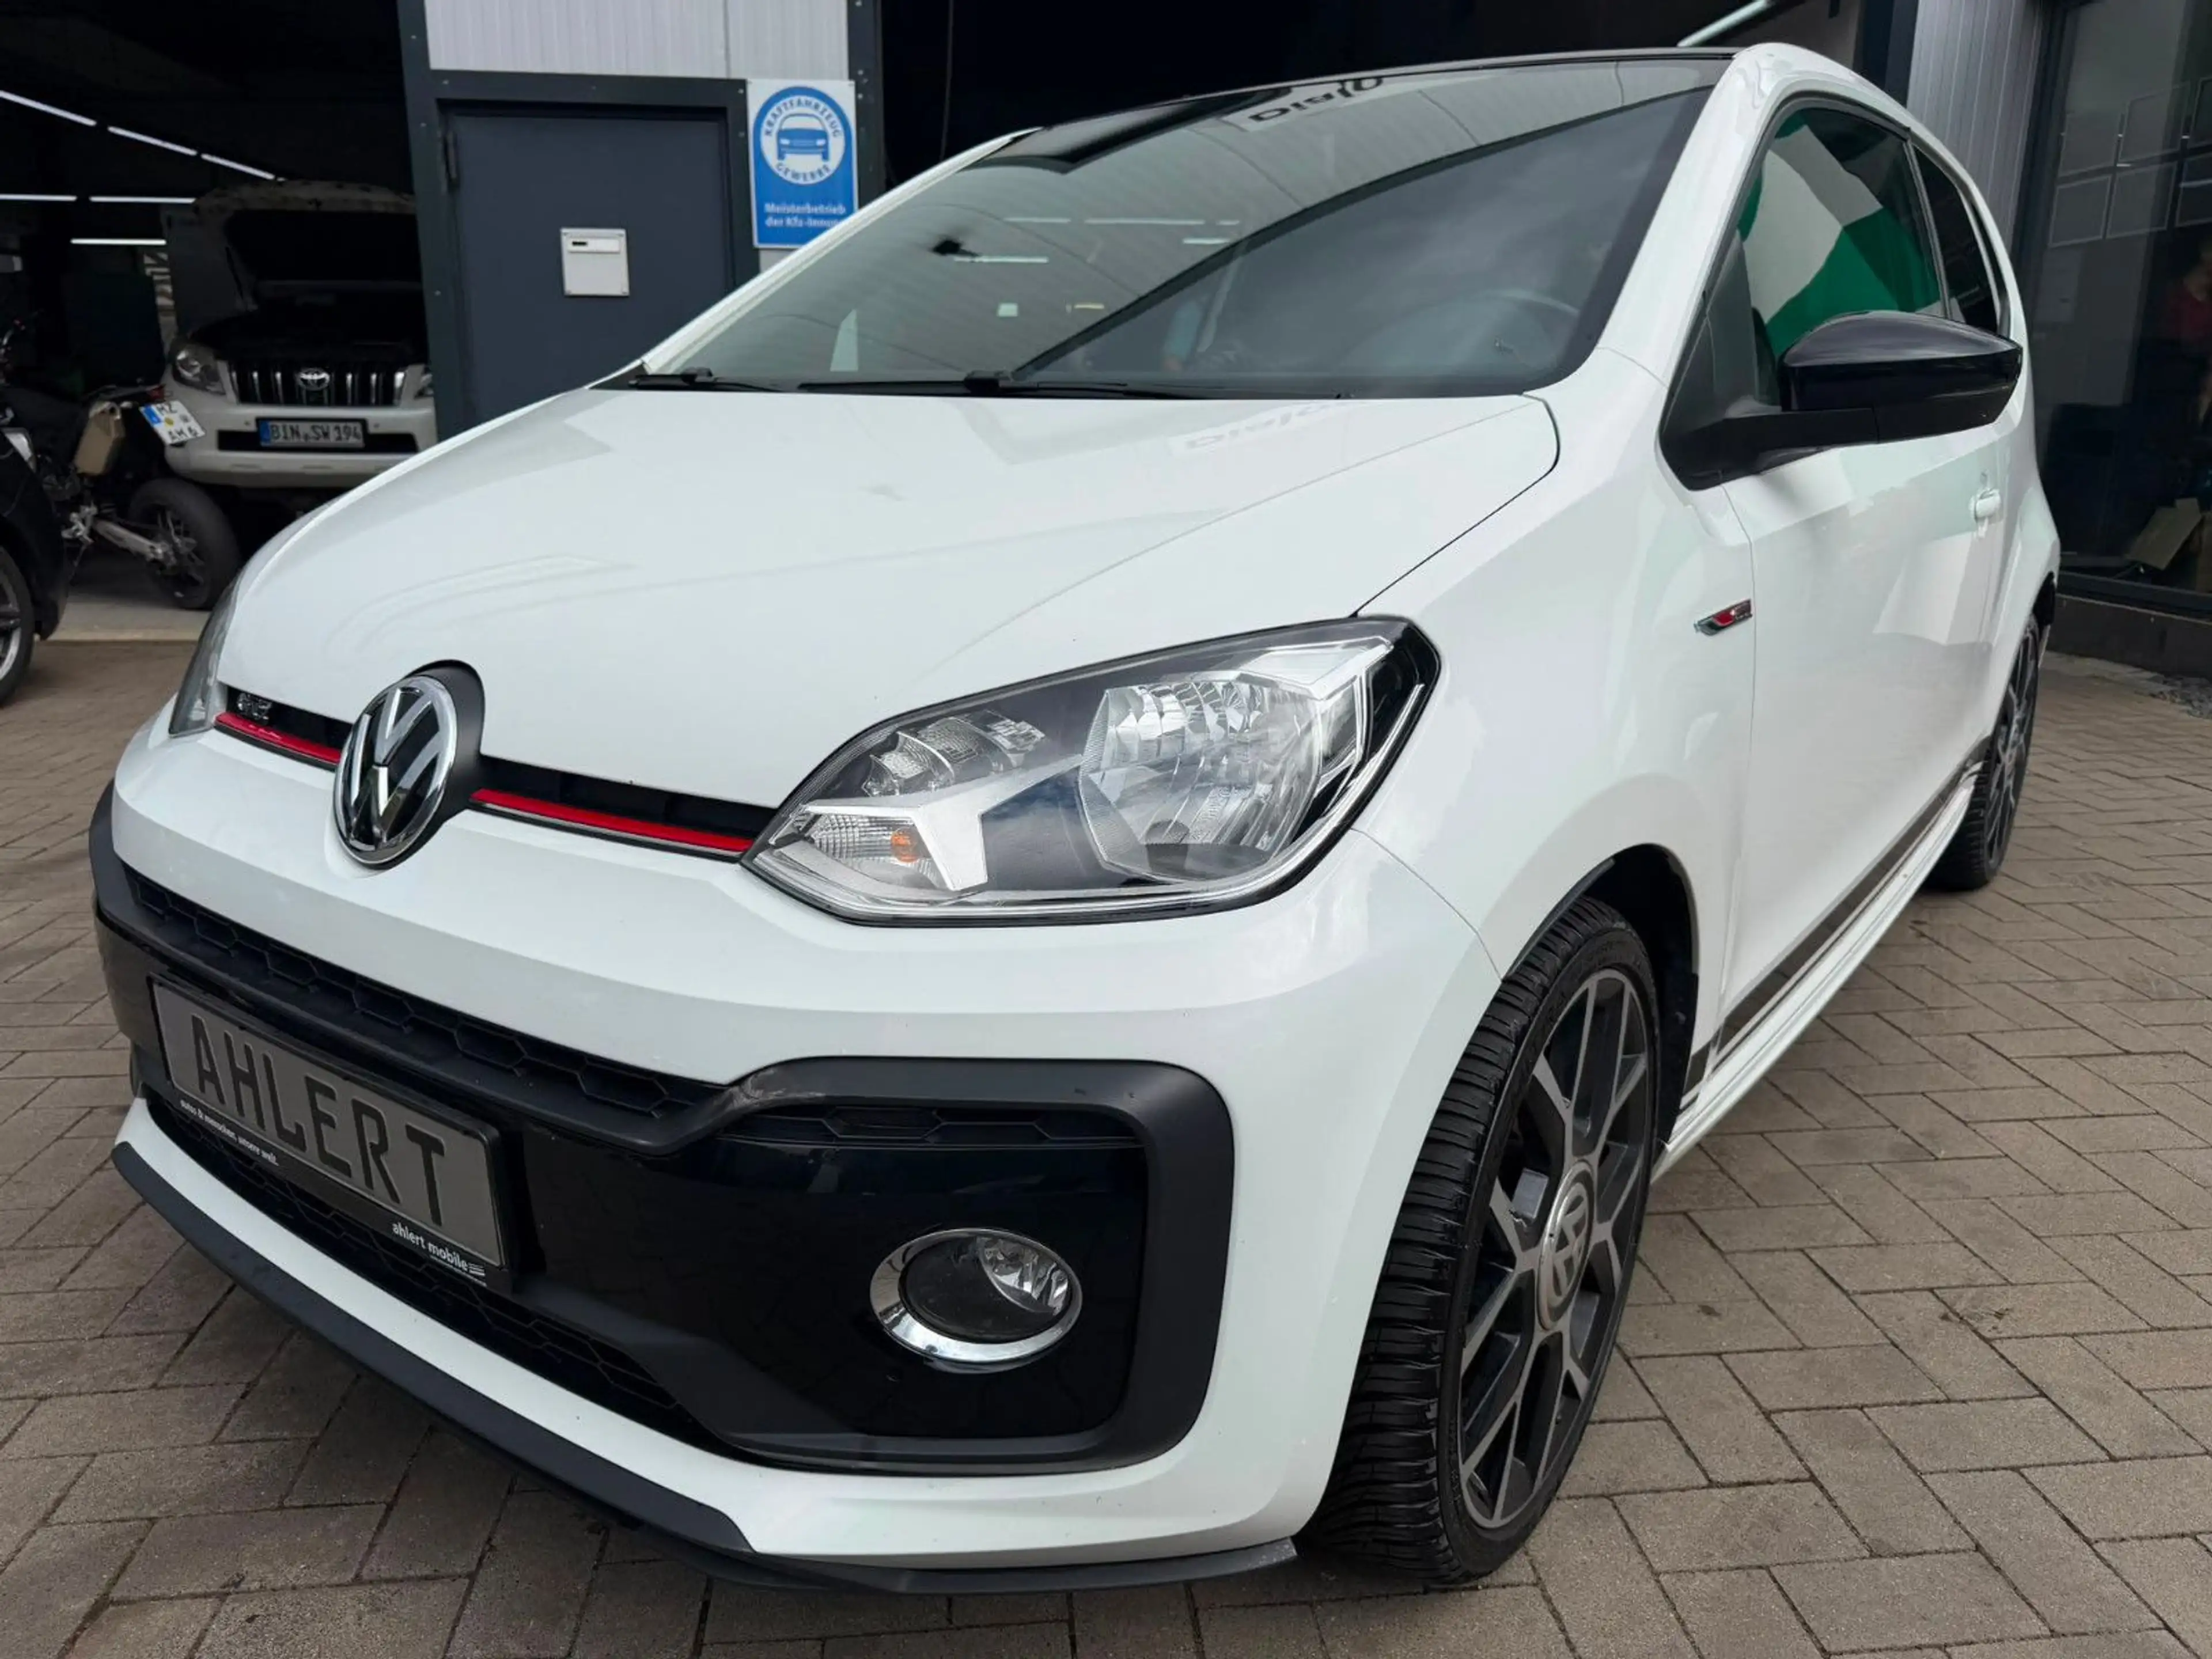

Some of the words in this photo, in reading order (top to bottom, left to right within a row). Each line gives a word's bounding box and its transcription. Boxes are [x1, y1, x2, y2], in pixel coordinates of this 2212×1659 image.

[764, 97, 840, 137] KRAFTFAHRZEUG
[775, 161, 830, 181] GEWERBE
[764, 203, 846, 215] Meisterbetrieb
[764, 216, 783, 227] der
[192, 1014, 445, 1226] AHLERT
[392, 1221, 426, 1249] ahlert
[428, 1242, 468, 1271] mobile
